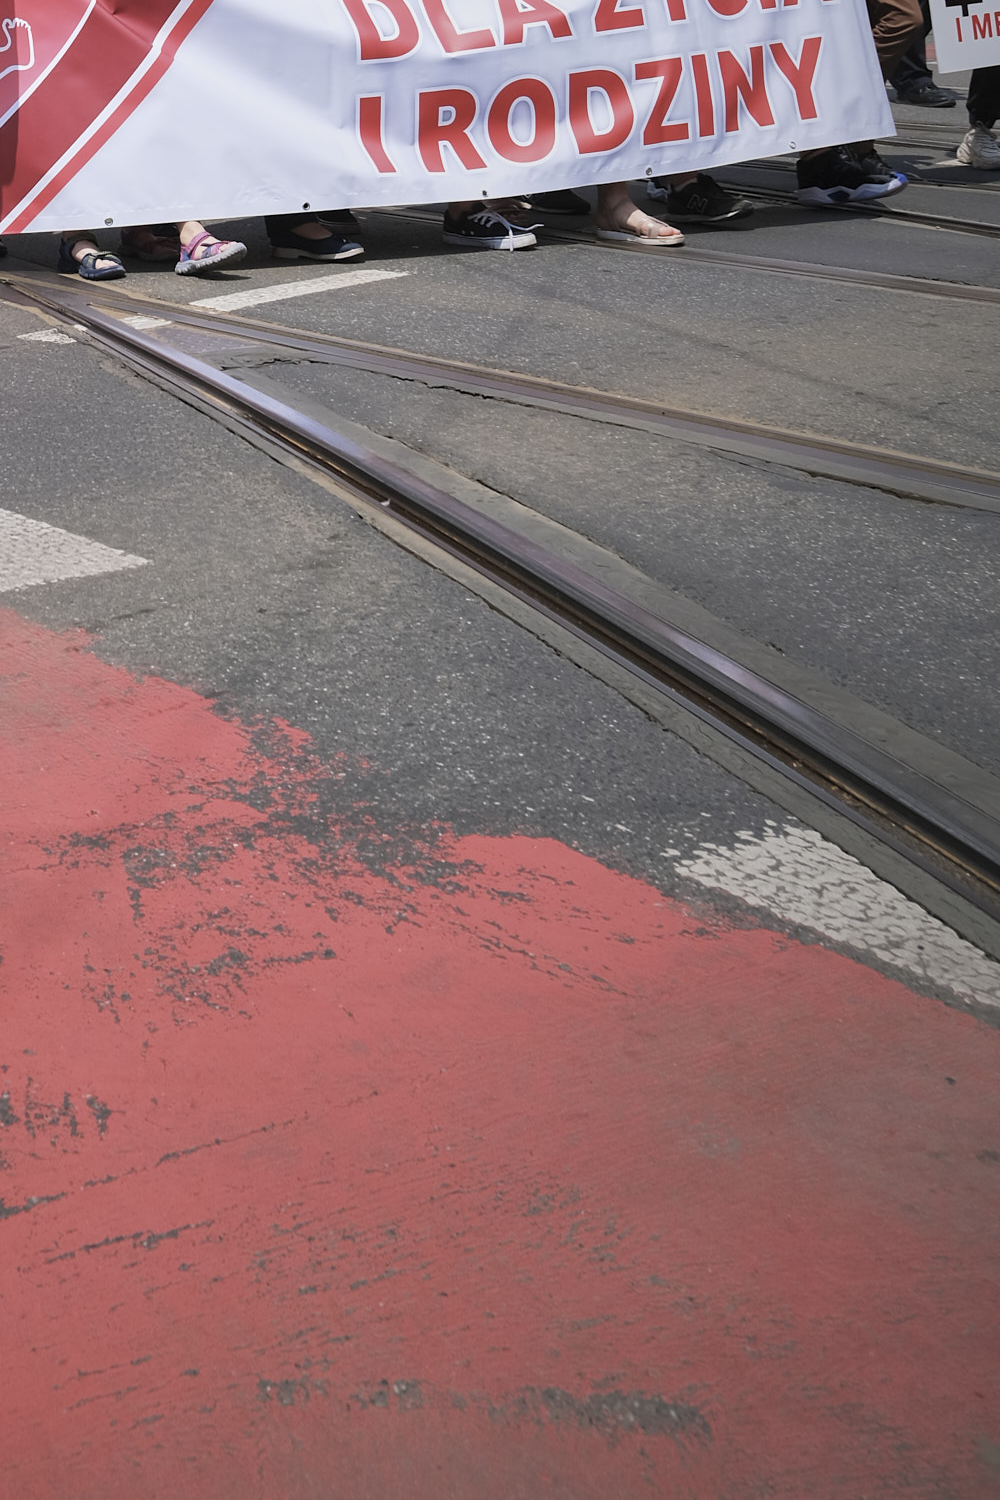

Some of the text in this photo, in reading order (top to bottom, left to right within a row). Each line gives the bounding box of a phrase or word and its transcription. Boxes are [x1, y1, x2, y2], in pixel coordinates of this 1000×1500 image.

[955, 17, 963, 43] I
[358, 36, 824, 174] I RODZINY
